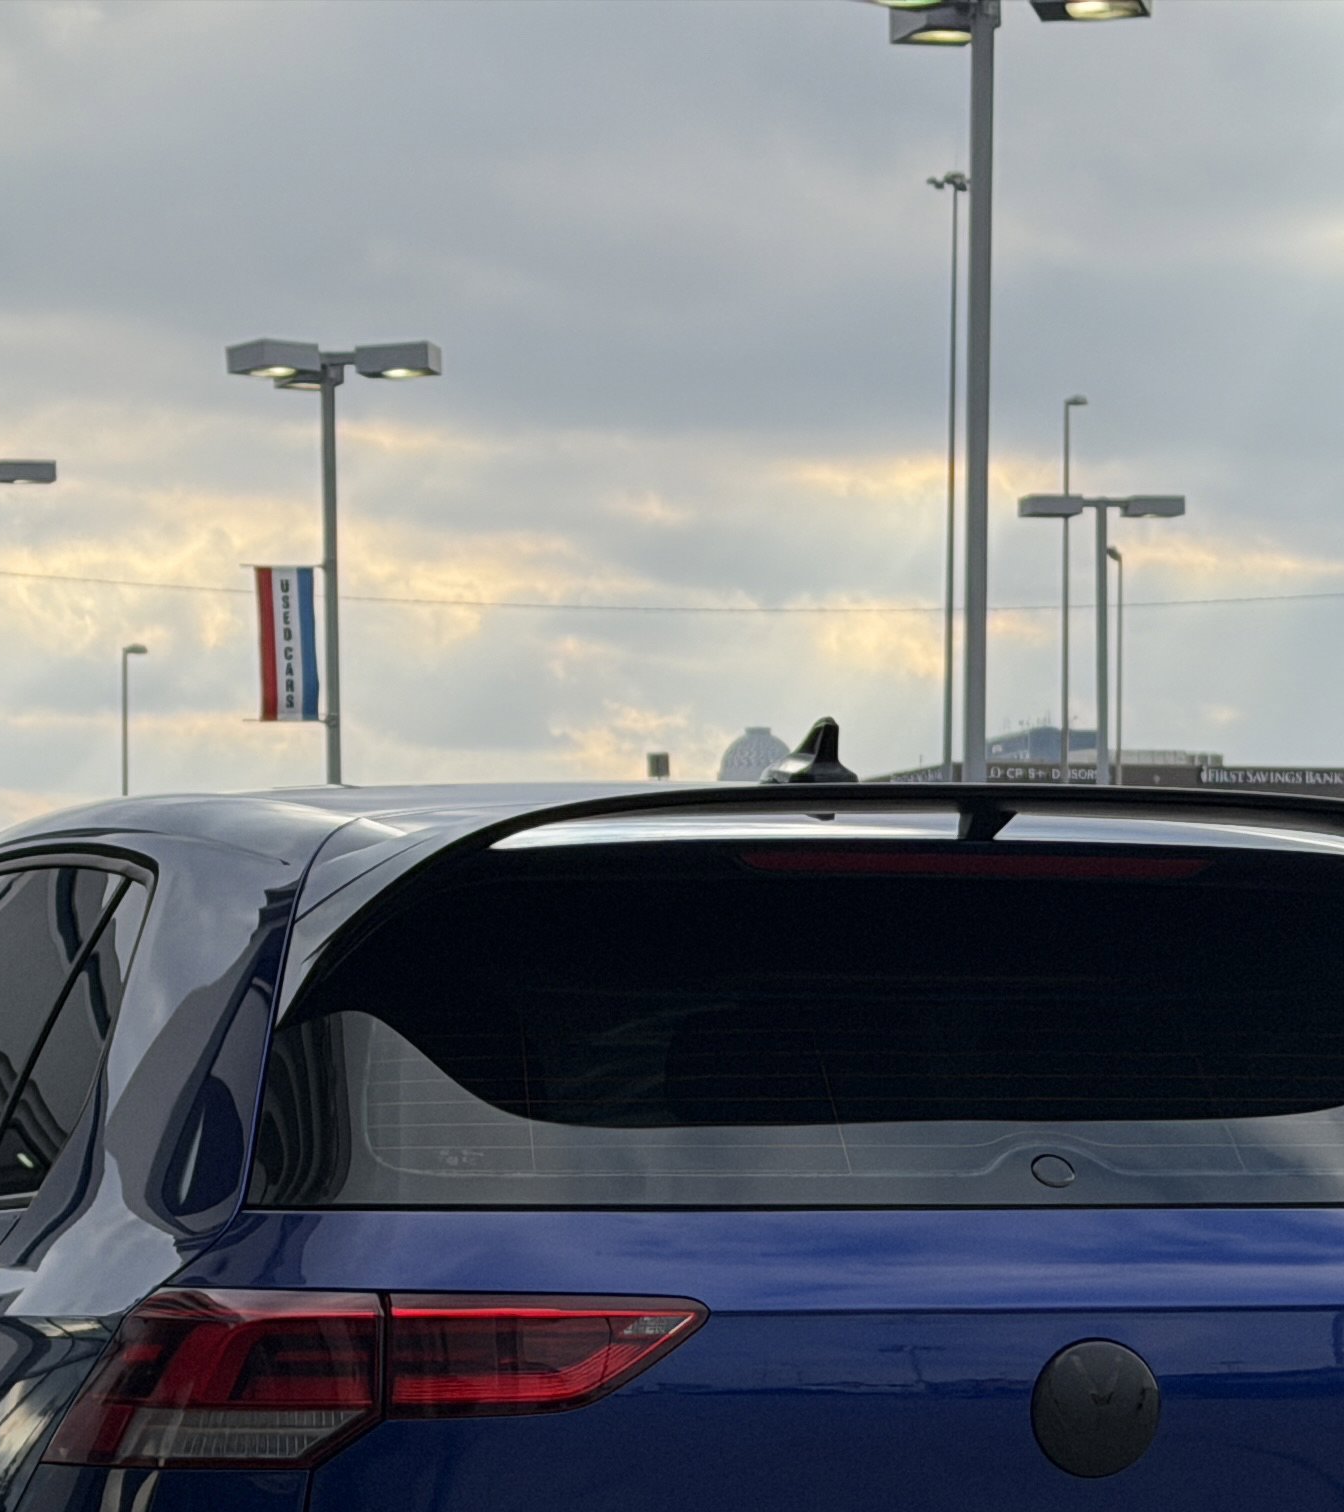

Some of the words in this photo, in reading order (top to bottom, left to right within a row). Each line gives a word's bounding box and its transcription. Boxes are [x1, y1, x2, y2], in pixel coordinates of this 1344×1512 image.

[280, 579, 292, 642] USED
[284, 647, 295, 709] CARS
[1246, 770, 1303, 785] SAVINGS
[1306, 771, 1343, 785] BANK
